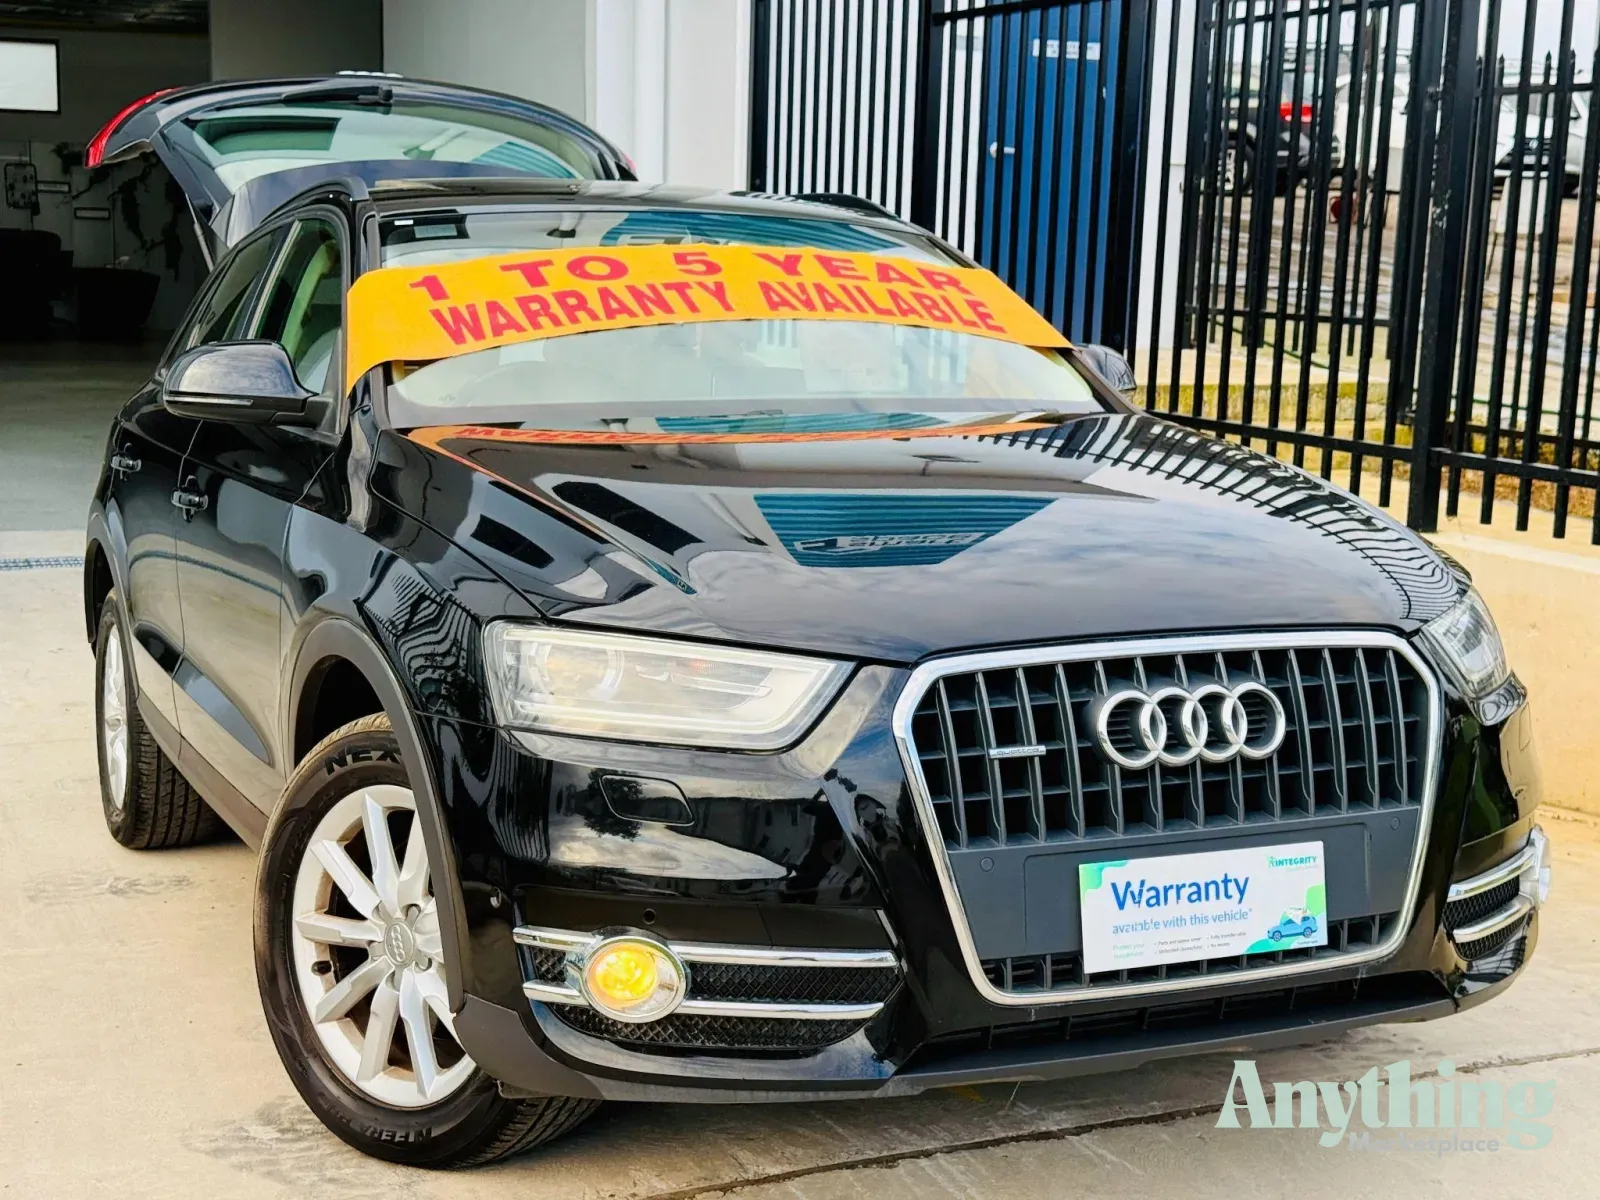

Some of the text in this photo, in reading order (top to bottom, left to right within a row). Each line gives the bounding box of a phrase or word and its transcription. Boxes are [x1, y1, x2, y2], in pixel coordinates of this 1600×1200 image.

[410, 252, 975, 301] 1 TO 5 YEAR
[429, 281, 1006, 345] WARRANTY AVAILABLE
[325, 745, 402, 776] NEX
[1275, 855, 1317, 867] INTEGRITY
[1110, 872, 1250, 911] Warranty
[1163, 915, 1187, 929] with
[1190, 913, 1209, 926] this
